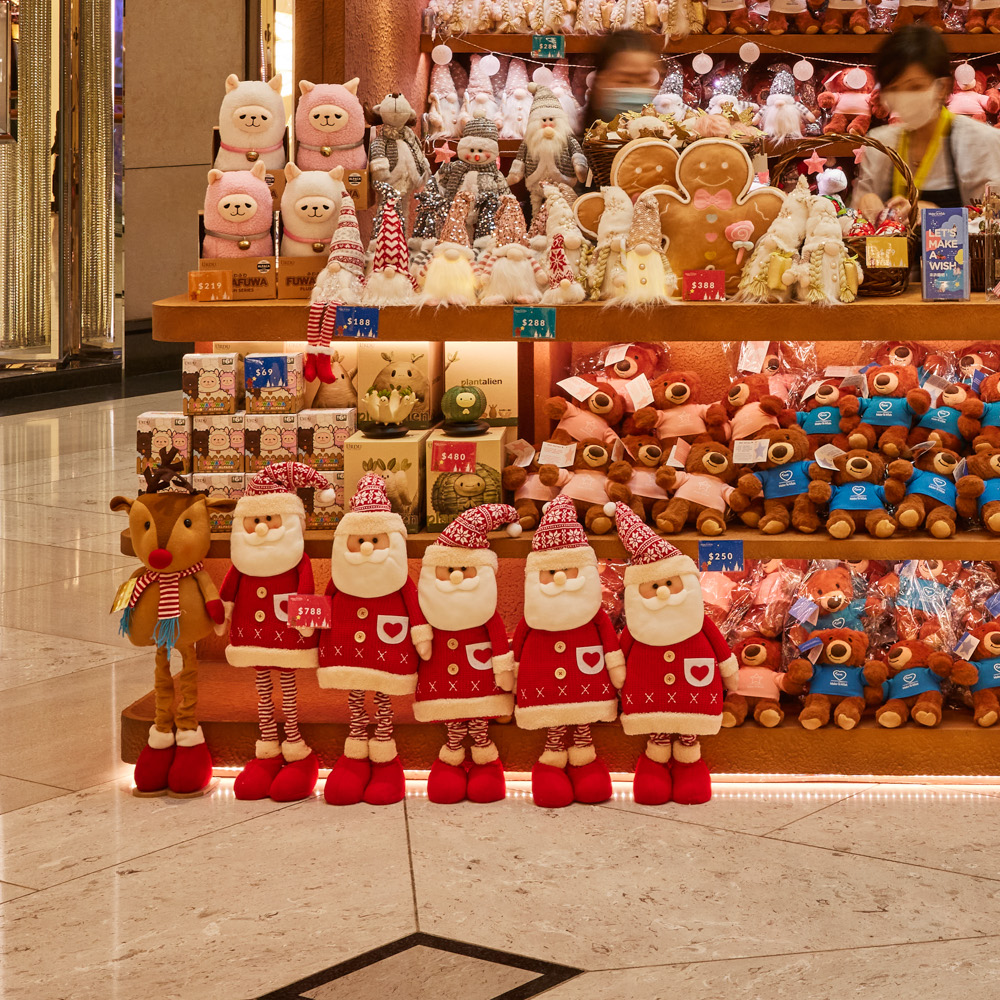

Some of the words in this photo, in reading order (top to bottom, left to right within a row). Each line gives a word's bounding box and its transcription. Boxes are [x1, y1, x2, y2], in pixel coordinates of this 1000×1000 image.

[928, 228, 957, 238] LET'S
[928, 239, 958, 248] MAKE
[929, 251, 937, 260] A
[929, 262, 957, 271] WISH
[198, 282, 222, 290] $219
[691, 281, 715, 290] $388
[347, 317, 371, 326] $188
[522, 318, 546, 327] $288
[255, 368, 273, 376] $69
[461, 378, 503, 386] plantalien
[441, 452, 466, 461] $480
[708, 552, 733, 561] $250
[298, 606, 322, 615] $788
